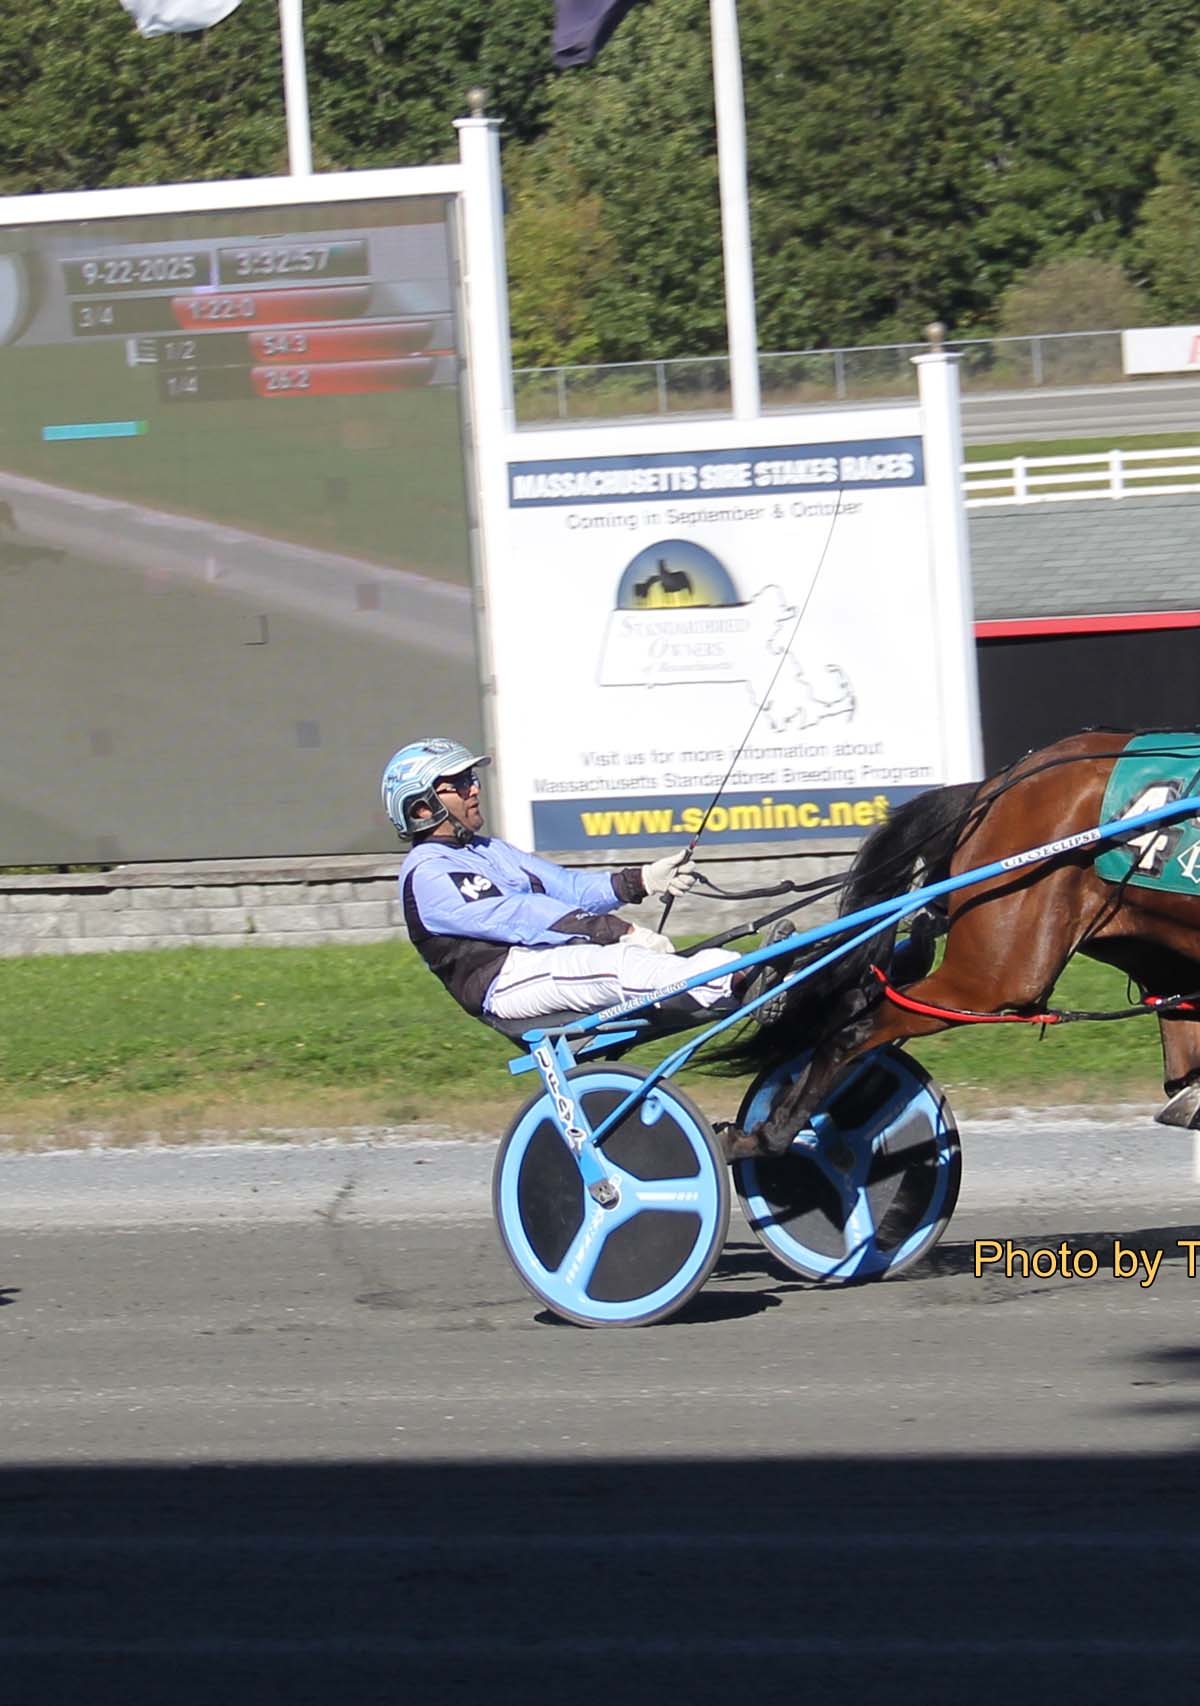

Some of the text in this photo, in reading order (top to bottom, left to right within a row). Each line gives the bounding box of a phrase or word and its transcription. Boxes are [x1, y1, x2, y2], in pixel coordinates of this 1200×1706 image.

[81, 256, 196, 284] 9-22-2025
[236, 249, 329, 275] 3:32:57
[513, 453, 914, 500] MASSACHUSETTS SIRE STAKES RACES
[566, 499, 863, 531] Coming in September & October
[579, 740, 883, 768] Visit us for more information about
[533, 763, 933, 795] Massachusetts Standardbred Breeding Program
[580, 795, 890, 836] www.sominc.net
[1043, 830, 1100, 856] ECLIPSE
